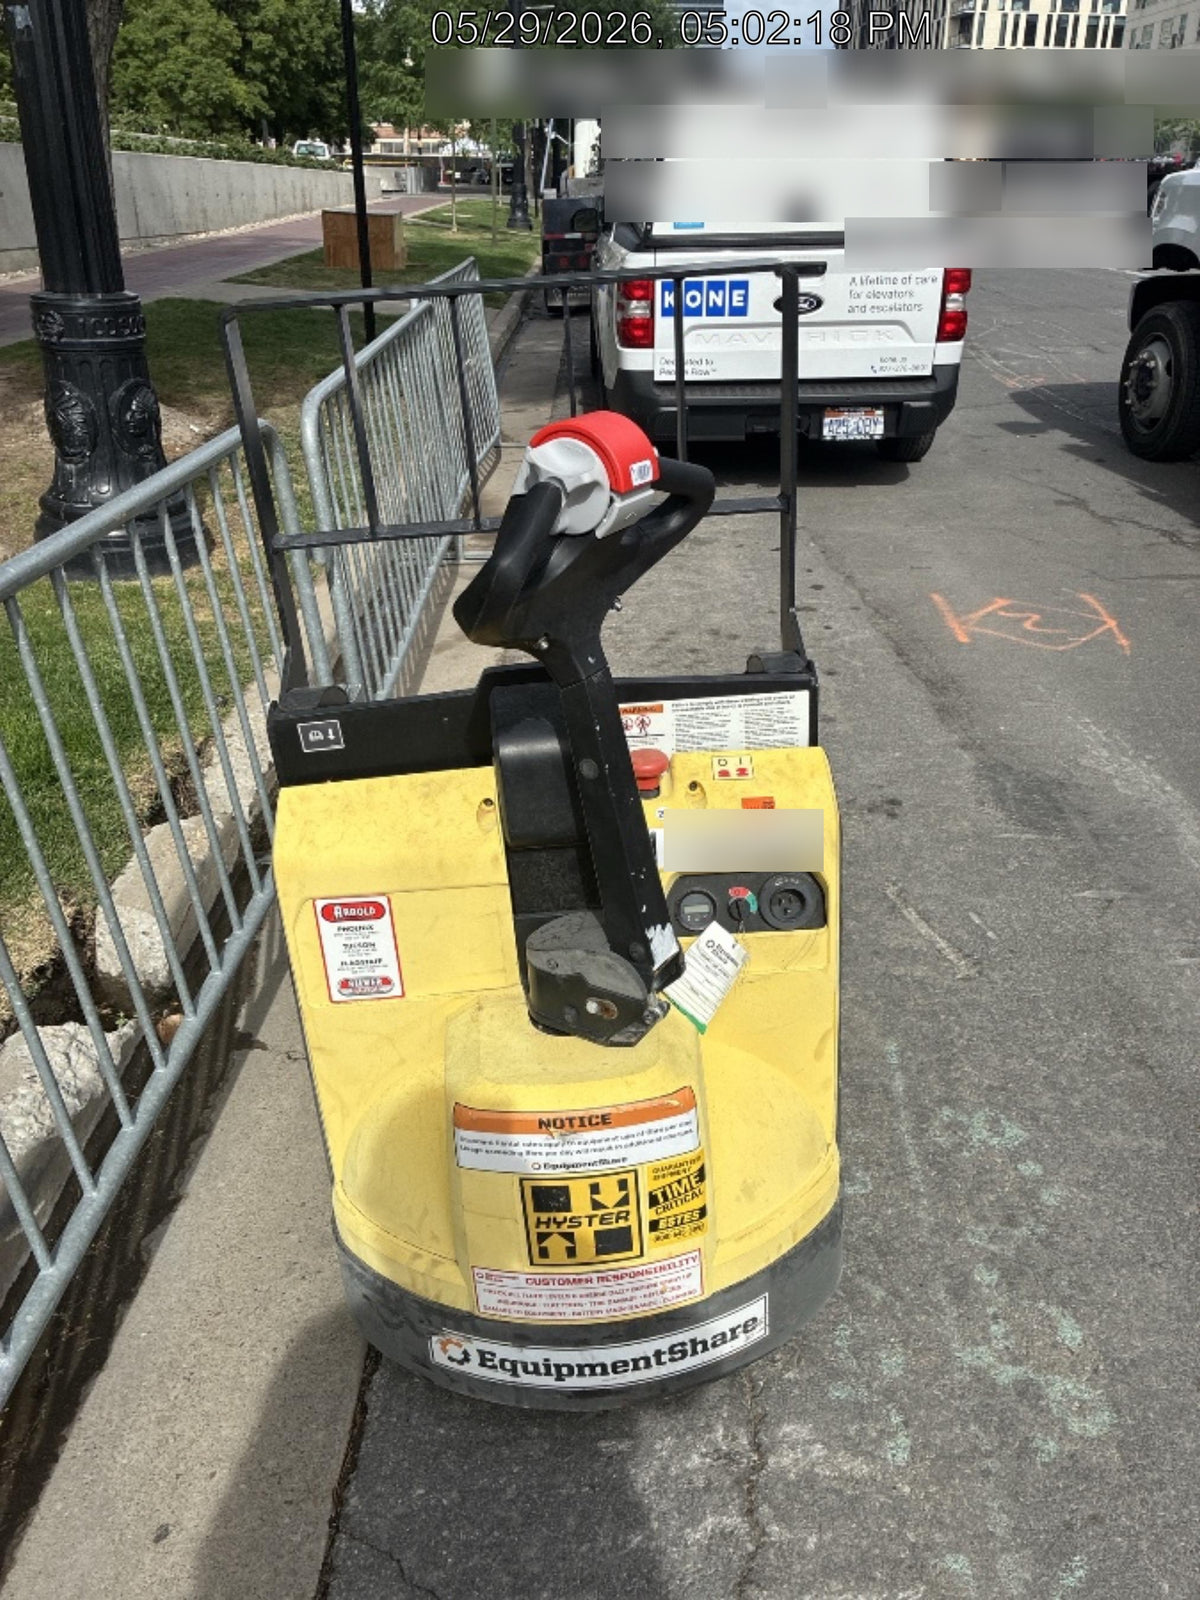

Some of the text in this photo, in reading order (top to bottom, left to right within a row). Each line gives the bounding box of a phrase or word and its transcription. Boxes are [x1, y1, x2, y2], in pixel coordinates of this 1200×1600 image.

[664, 289, 746, 309] KONE
[538, 1113, 613, 1129] NOTICE
[652, 1175, 700, 1204] TIME
[655, 1187, 703, 1216] CRITICAL
[535, 1210, 630, 1229] HYSTER
[476, 1316, 758, 1382] EquipmentShare
